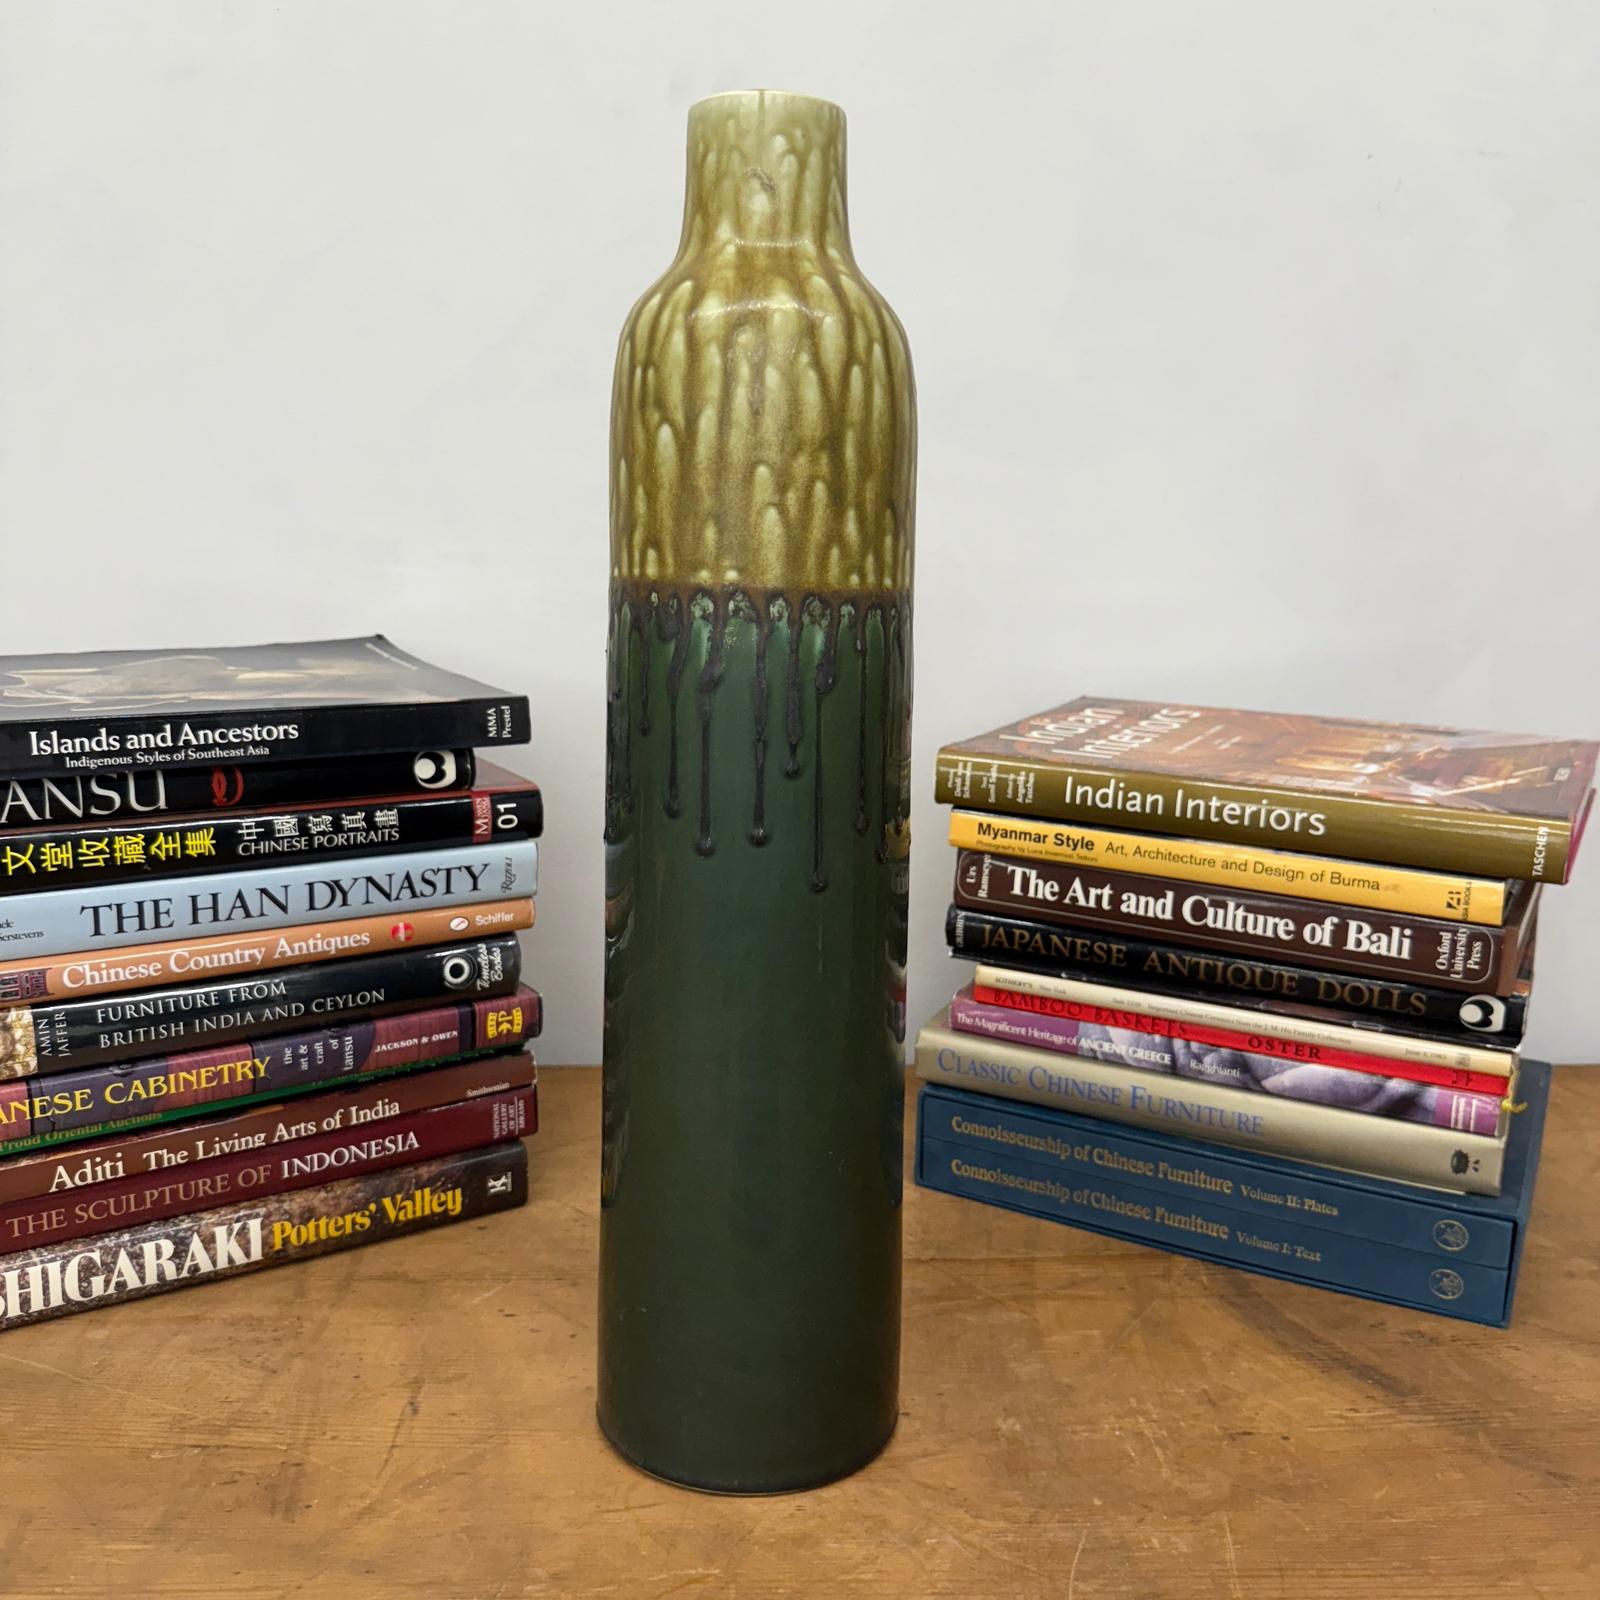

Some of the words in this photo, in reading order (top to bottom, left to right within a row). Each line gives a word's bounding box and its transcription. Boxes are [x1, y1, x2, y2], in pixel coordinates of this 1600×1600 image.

[29, 727, 121, 756] Islands
[126, 724, 174, 749] and
[179, 721, 299, 746] Ancestors
[486, 708, 497, 738] MMA
[501, 705, 512, 738] Prestel
[65, 757, 133, 770] Indigenous
[136, 751, 171, 765] Styles
[173, 750, 186, 762] of
[188, 747, 245, 760] Southeast
[247, 744, 270, 757] Asia
[0, 770, 168, 823] ANSU
[497, 803, 518, 829] 01
[1065, 776, 1164, 816] Indian
[1175, 789, 1327, 836] Interiors
[2, 827, 216, 876] 文堂收藏全集
[238, 836, 309, 856] CHINESE
[314, 828, 400, 848] PORTRAITS
[977, 822, 1049, 845] Myanmar
[1053, 832, 1095, 851] Style
[1105, 842, 1128, 858] Art,
[1132, 846, 1217, 868] Architecture
[1221, 858, 1248, 873] and
[1253, 860, 1305, 881] Design
[1310, 869, 1326, 885] of
[1330, 872, 1380, 891] Burma
[1532, 827, 1549, 877] TASCHEN
[80, 897, 175, 937] THE
[188, 884, 292, 926] HAN
[305, 863, 491, 912] DYNASTY
[476, 912, 515, 926] Schiffer
[1006, 865, 1059, 900] The
[1062, 876, 1115, 911] Art
[1120, 890, 1174, 920] and
[1182, 894, 1297, 941] Culture
[1302, 915, 1338, 947] of
[1343, 919, 1412, 960] Bali
[62, 961, 163, 989] Chinese
[169, 946, 266, 974] Country
[273, 932, 370, 960] Antiques
[981, 924, 1128, 967] JAPANESE
[1143, 950, 1300, 995] ANTIQUE
[1317, 976, 1427, 1015] DOLLS
[1435, 931, 1452, 970] Oxford
[1450, 928, 1470, 978] University
[1466, 941, 1482, 970] Press
[96, 990, 220, 1024] FURNITURE
[229, 981, 287, 1003] FROM
[100, 1022, 185, 1049] BRITISH
[195, 1012, 255, 1033] INDIA
[262, 1003, 305, 1022] AND
[312, 988, 386, 1014] CEYLON
[993, 989, 1082, 1016] BAMBOO
[1093, 1006, 1187, 1035] BASKETS
[1247, 1035, 1322, 1059] OSTER
[38, 1018, 52, 1057] AMIN
[54, 1010, 72, 1057] JAFFER
[283, 1046, 294, 1066] the
[314, 1041, 324, 1065] craft
[329, 1038, 339, 1050] of
[375, 1037, 419, 1053] JACKSON
[421, 1035, 430, 1044] &
[431, 1030, 458, 1042] OWEN
[957, 1012, 974, 1026] The
[974, 1017, 1027, 1037] Magnificent
[1028, 1026, 1066, 1045] Heritage
[1066, 1034, 1078, 1047] of
[1078, 1037, 1128, 1056] ANCIENT
[1129, 1046, 1172, 1065] GREECE
[105, 1056, 272, 1105] CABINETRY
[300, 1058, 309, 1071] art
[936, 1047, 1023, 1085] CLASSIC
[1028, 1065, 1123, 1105] CHINESE
[1129, 1085, 1264, 1135] FURNITURE
[45, 1122, 102, 1142] Oriental
[49, 1152, 126, 1193] Aditi
[143, 1149, 189, 1172] The
[196, 1133, 266, 1160] Living
[272, 1121, 316, 1145] Arts
[323, 1110, 344, 1132] of
[350, 1099, 400, 1126] India
[6, 1208, 68, 1239] THE
[75, 1173, 231, 1224] SCULPTURE
[237, 1164, 272, 1189] OF
[281, 1131, 420, 1179] INDONESIA
[951, 1115, 1071, 1160] Connoisseurship
[1073, 1143, 1093, 1162] of
[1092, 1149, 1154, 1177] Chinese
[1157, 1162, 1234, 1195] Furniture
[1240, 1184, 1284, 1205] Volume
[1303, 1199, 1340, 1217] Plates
[951, 1158, 1070, 1204] Connoisseurship
[1073, 1187, 1093, 1206] of
[1091, 1192, 1151, 1220] Chinese
[1154, 1206, 1230, 1240] Furniture
[1236, 1231, 1280, 1252] Volume
[1294, 1245, 1322, 1262] Text
[0, 1217, 265, 1318] HIGARAKI
[272, 1202, 377, 1251] Potters'
[381, 1187, 462, 1224] Valley
